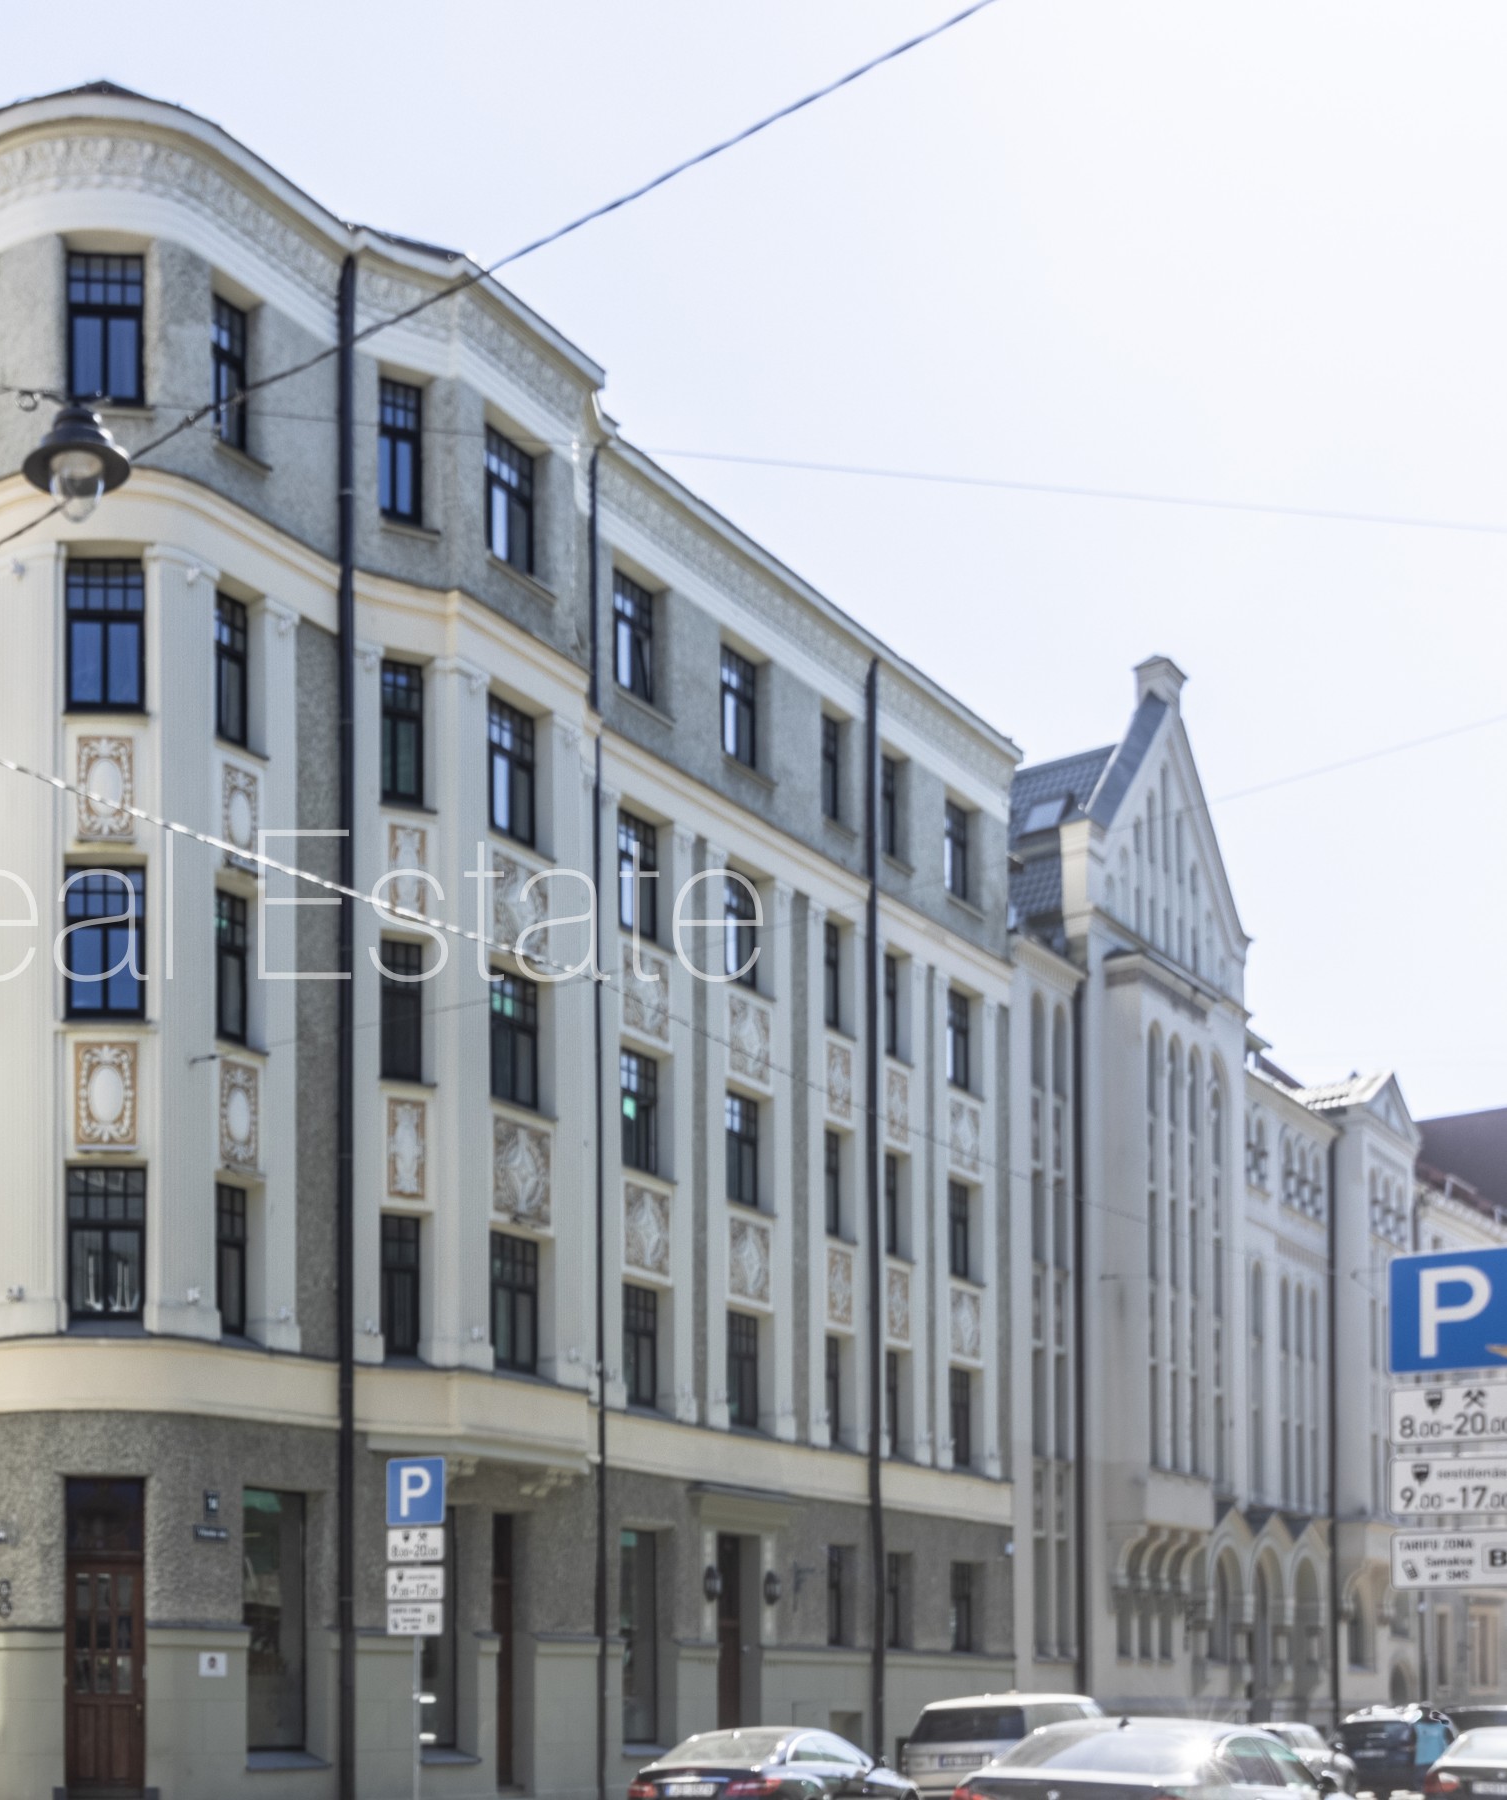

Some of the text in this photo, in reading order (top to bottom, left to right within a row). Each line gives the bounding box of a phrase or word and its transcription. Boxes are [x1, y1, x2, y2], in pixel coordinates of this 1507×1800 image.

[1418, 1264, 1491, 1359] P
[399, 1466, 432, 1518] P
[1442, 1538, 1473, 1550] ZONA
[1446, 1569, 1470, 1580] SMS
